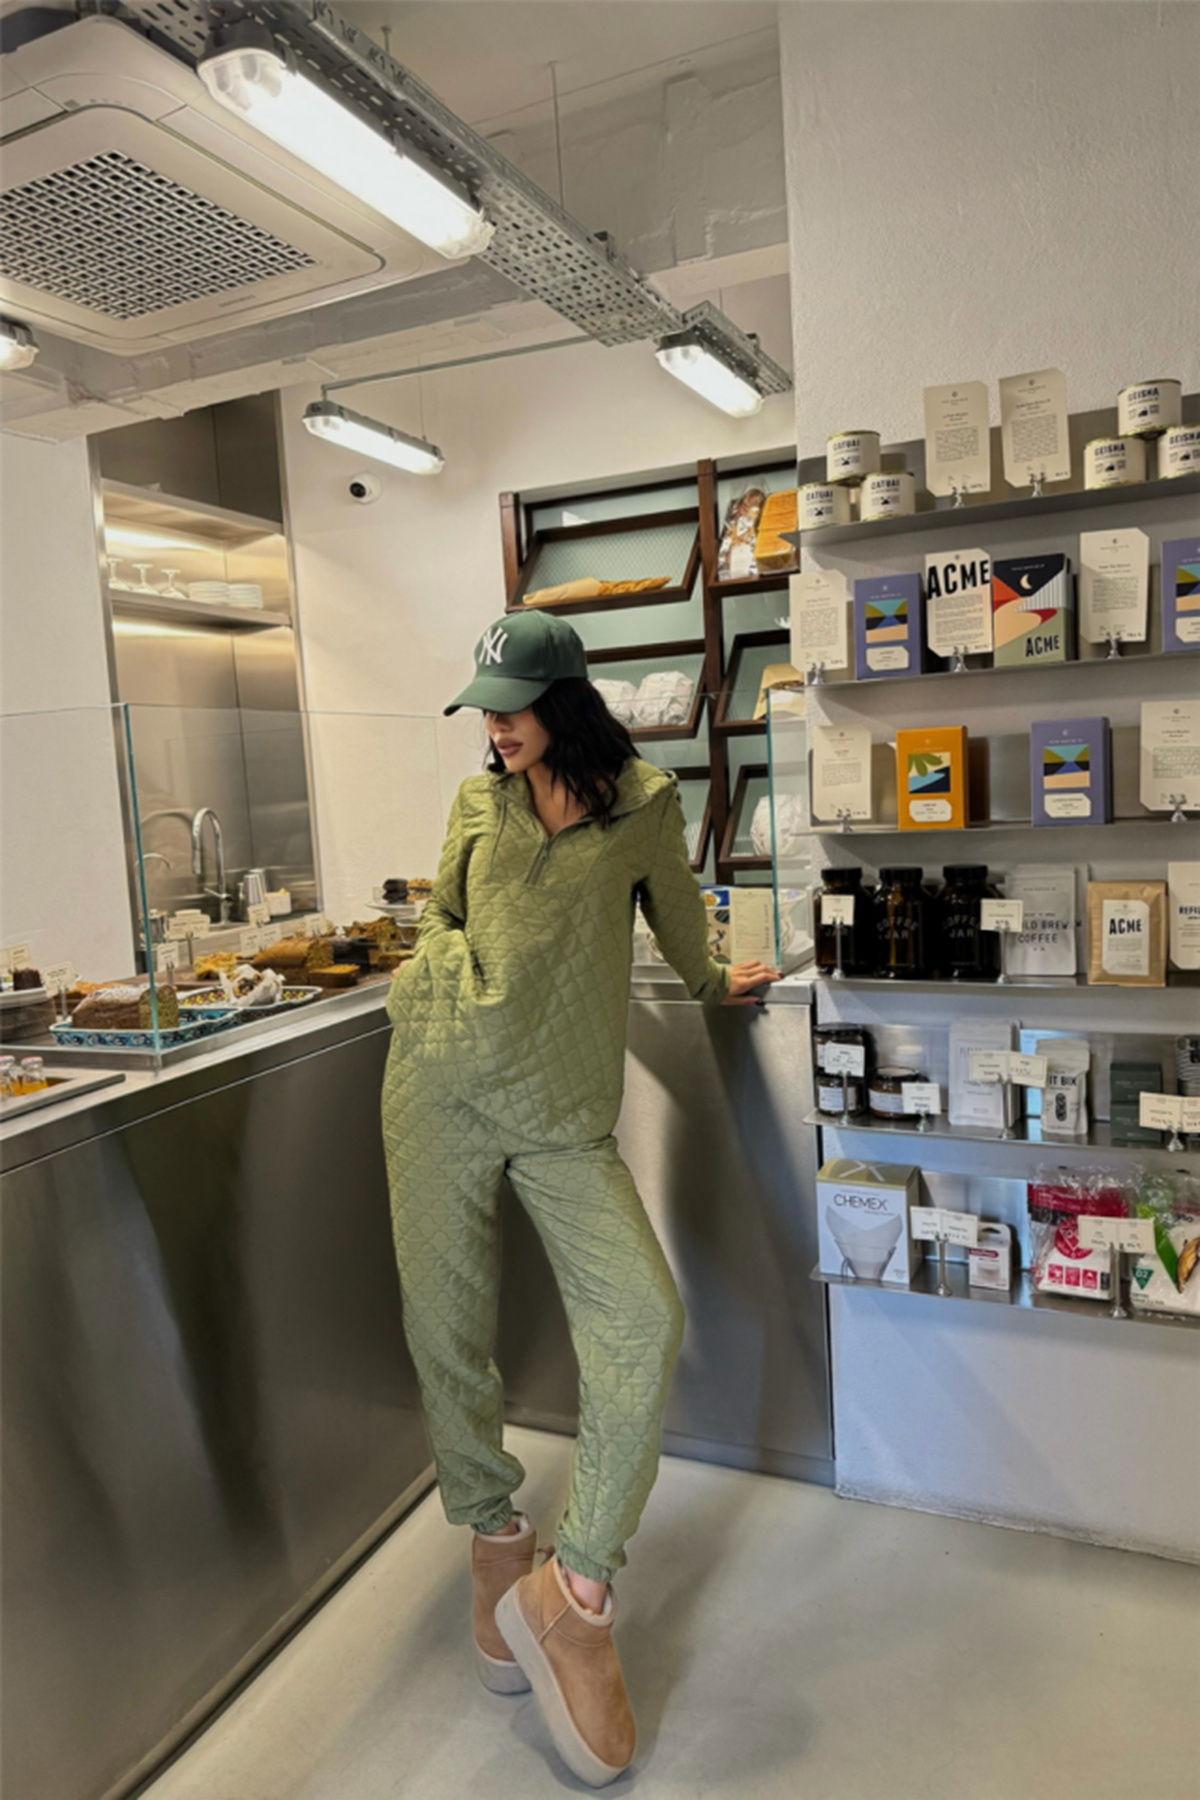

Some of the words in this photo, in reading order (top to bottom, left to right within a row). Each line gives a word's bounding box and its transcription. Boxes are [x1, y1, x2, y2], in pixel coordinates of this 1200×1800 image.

[1127, 387, 1159, 402] GEISHA
[1094, 443, 1125, 457] GEISHA
[926, 560, 990, 601] ACME
[479, 626, 508, 666] NY
[1025, 635, 1060, 658] ACME
[877, 916, 918, 932] COFFEE
[1041, 919, 1068, 931] BREW
[1109, 918, 1142, 936] ACME
[885, 929, 909, 940] JAR
[949, 928, 975, 939] JAR
[1018, 932, 1059, 944] COFFEE
[833, 1193, 889, 1212] CHEMEX
